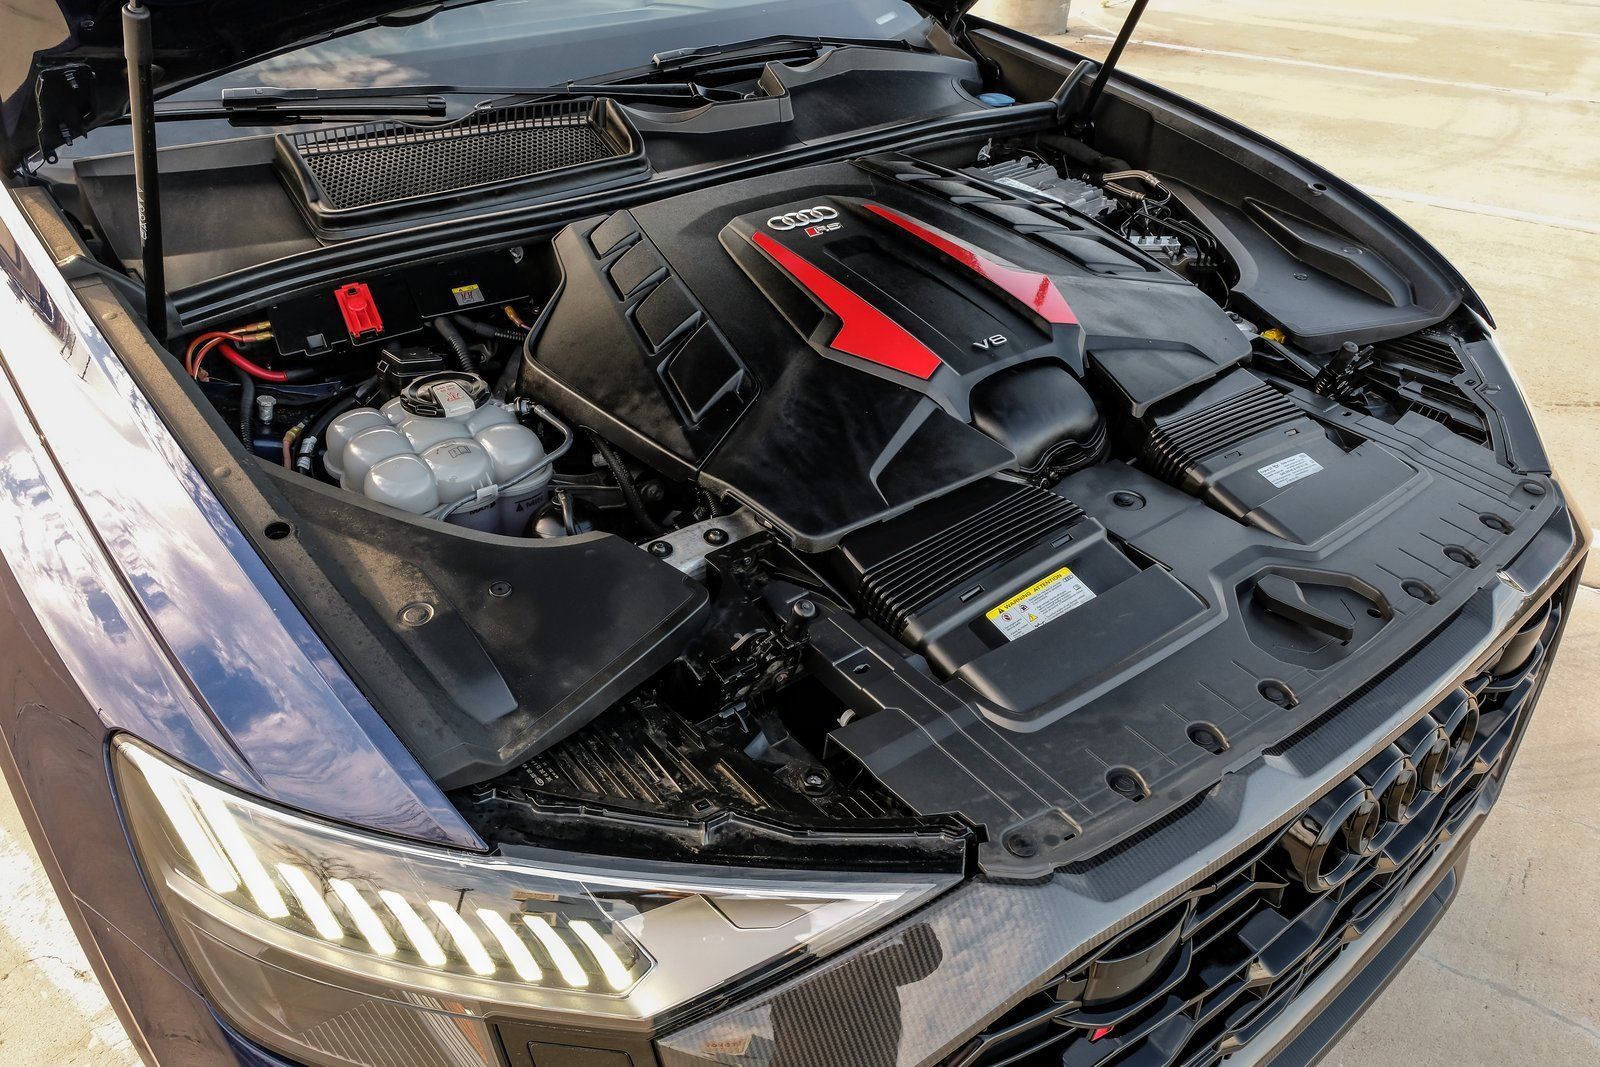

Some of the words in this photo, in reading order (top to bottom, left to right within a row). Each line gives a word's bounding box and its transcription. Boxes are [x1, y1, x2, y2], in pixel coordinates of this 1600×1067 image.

[806, 222, 842, 236] RS
[973, 334, 1007, 349] V8
[1003, 592, 1032, 609] WARNING
[1033, 574, 1062, 592] ATTENTION
